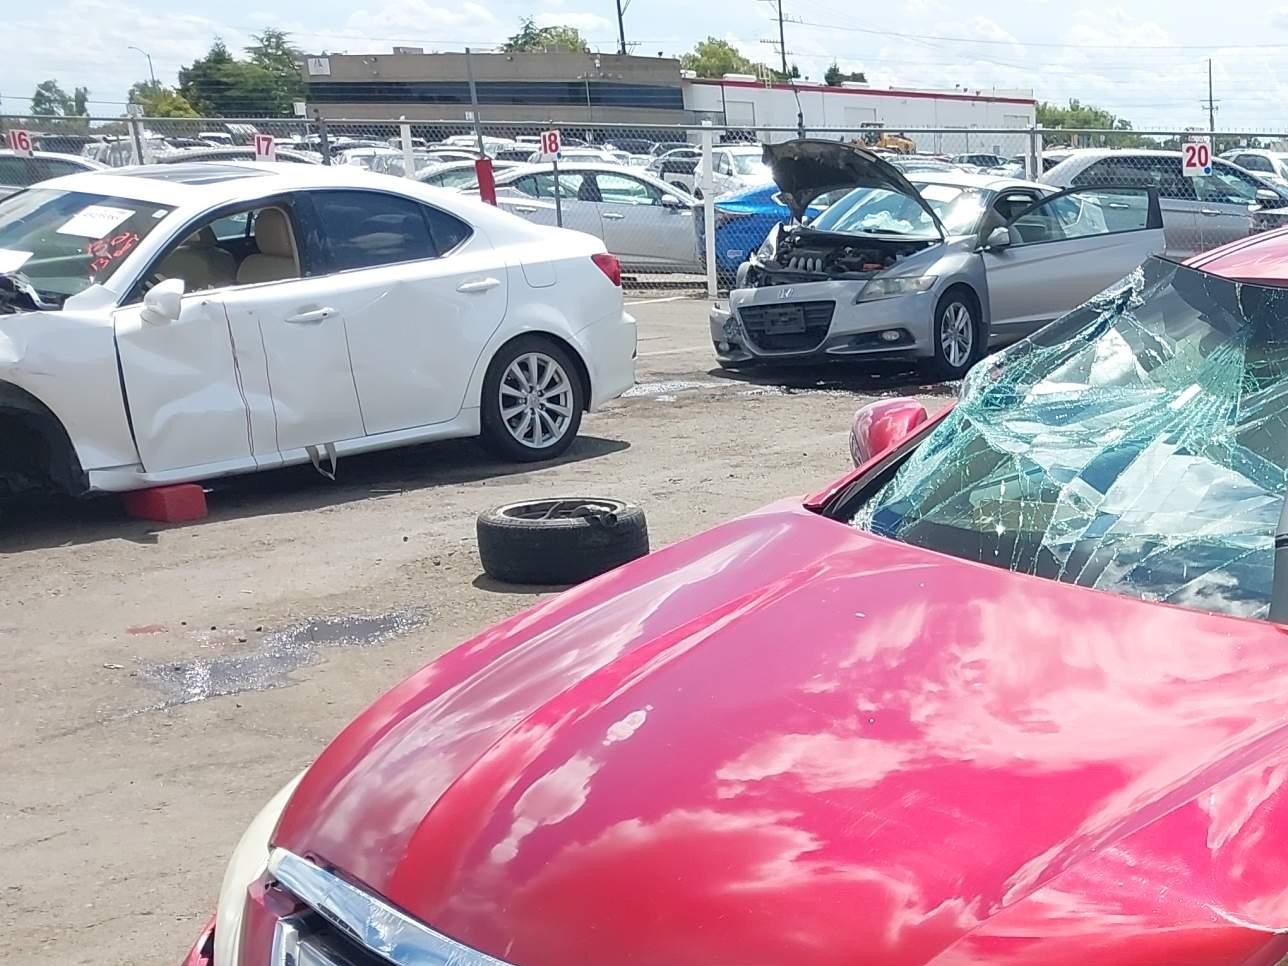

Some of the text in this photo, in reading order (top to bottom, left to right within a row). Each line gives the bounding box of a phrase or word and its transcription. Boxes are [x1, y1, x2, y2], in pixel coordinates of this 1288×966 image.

[10, 130, 30, 151] 16
[256, 136, 273, 156] 17
[542, 132, 560, 154] 18
[1185, 144, 1209, 168] 20
